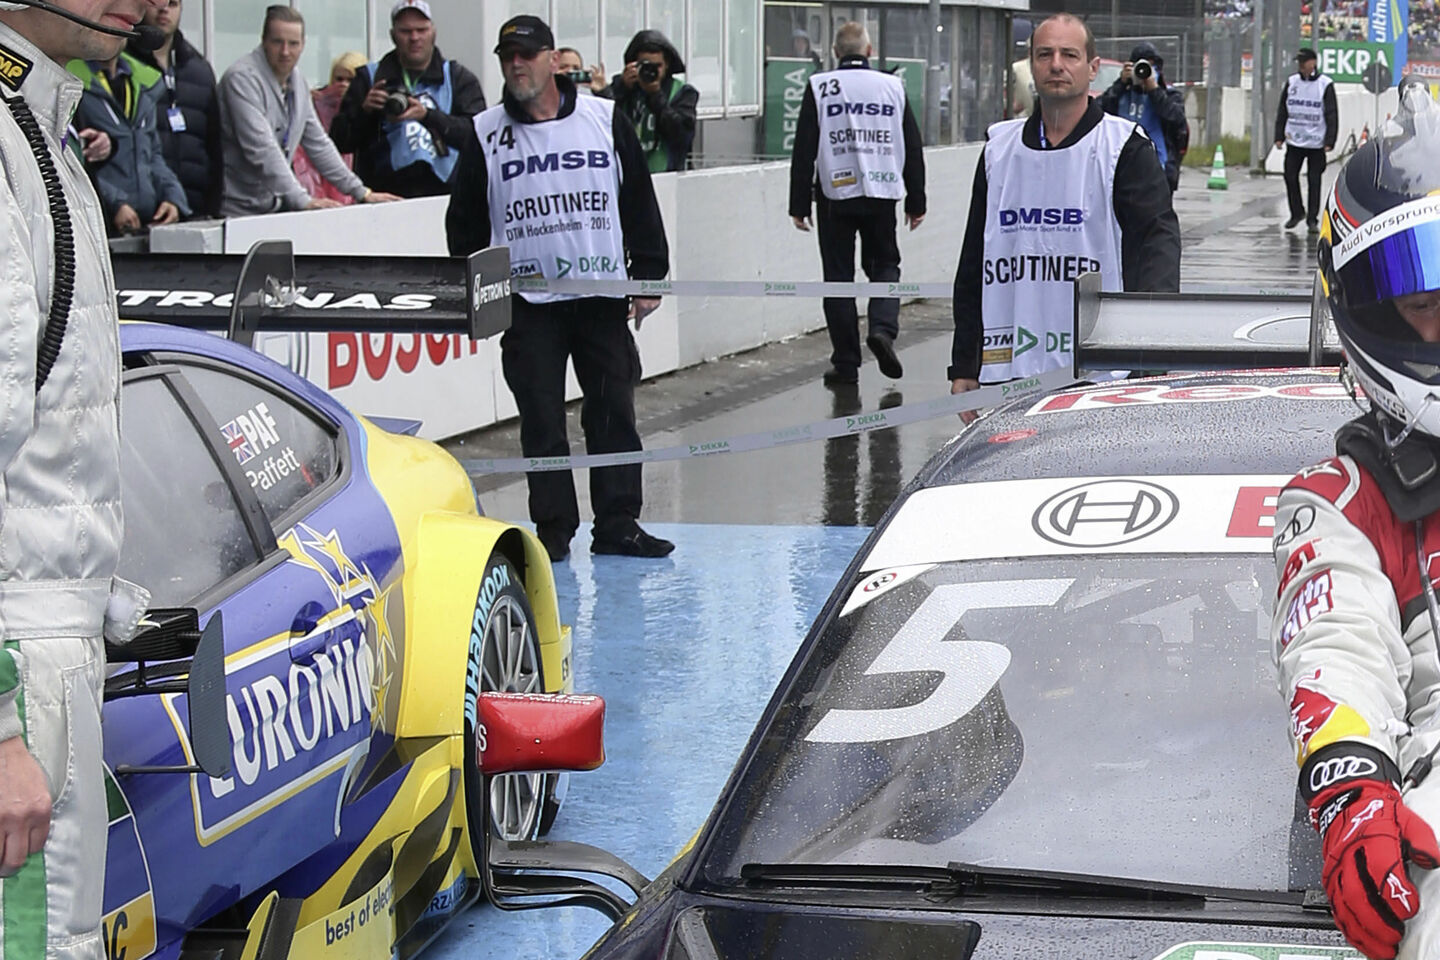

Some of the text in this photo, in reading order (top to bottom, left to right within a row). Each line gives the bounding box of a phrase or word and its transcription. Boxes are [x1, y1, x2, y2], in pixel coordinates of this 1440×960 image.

[819, 79, 841, 99] 23
[827, 101, 895, 118] DMSB
[501, 150, 610, 182] DMSB
[999, 208, 1084, 227] DMSB
[506, 227, 526, 242] DTM
[527, 219, 583, 238] Hockenheim
[1340, 233, 1364, 256] Audi
[983, 333, 1014, 347] DTM
[1013, 378, 1041, 392] DEKRA
[239, 401, 281, 456] PAF
[857, 413, 887, 426] DEKRA
[701, 440, 729, 452] DEKRA
[245, 447, 301, 491] Paffett
[803, 577, 1077, 743] 5
[325, 910, 356, 946] best
[358, 895, 371, 927] of
